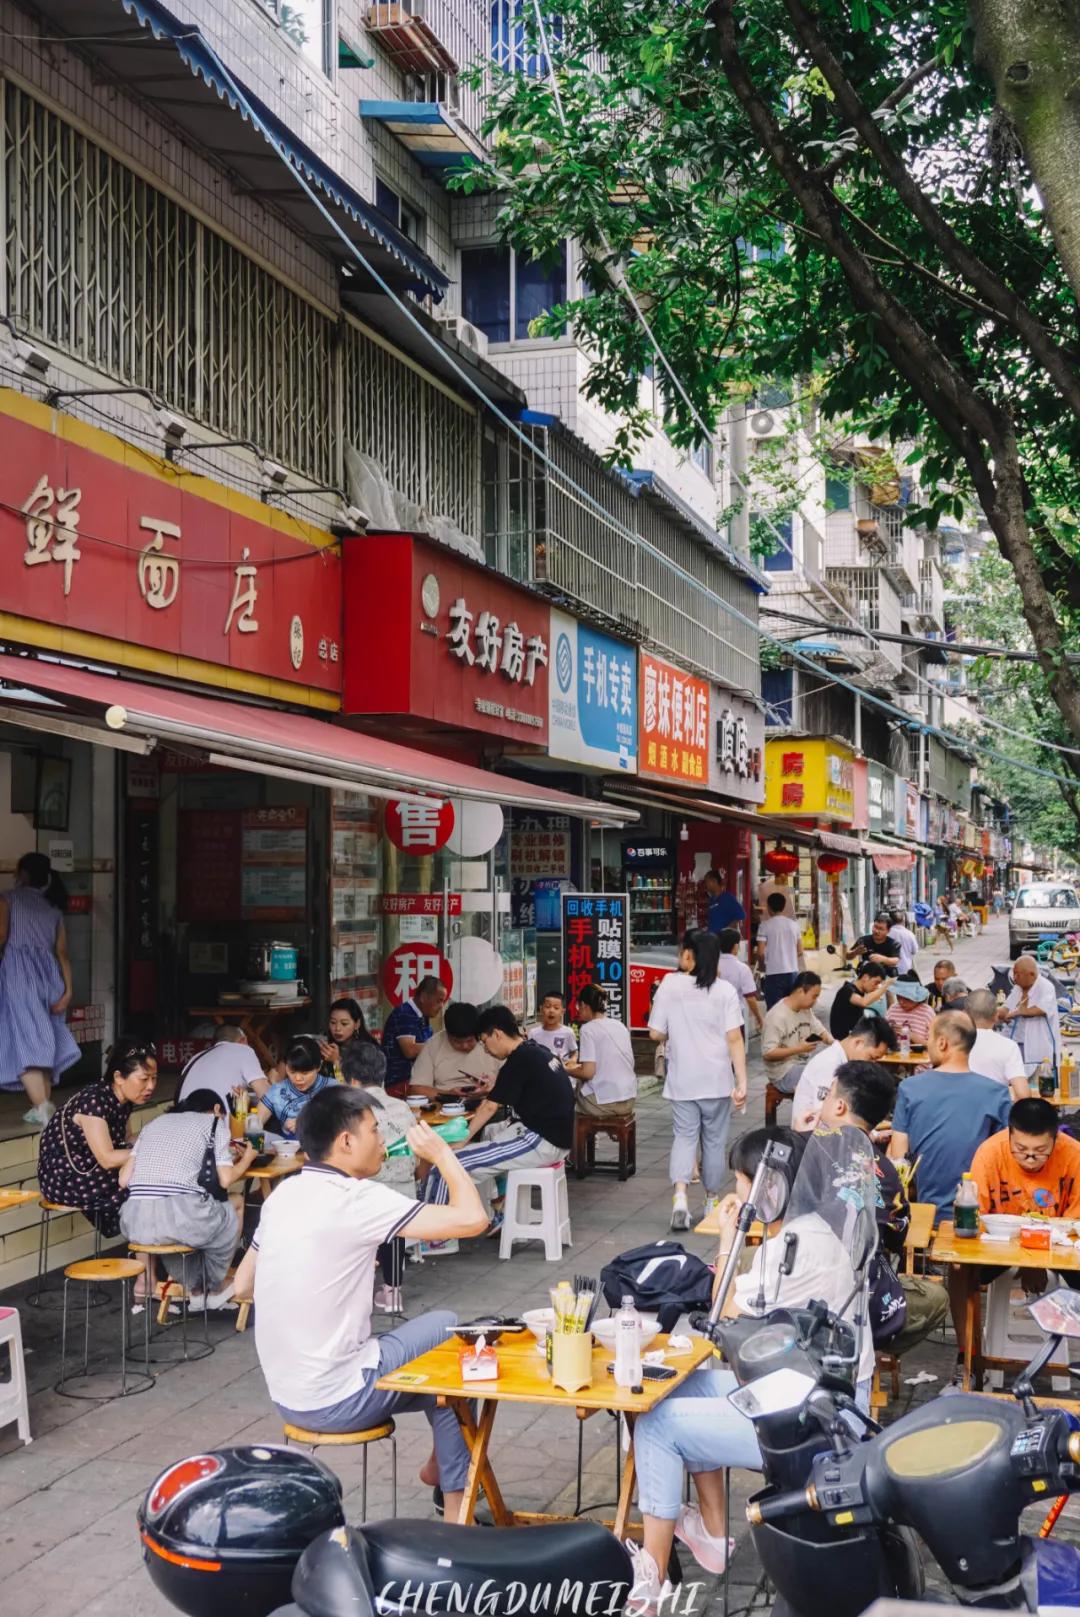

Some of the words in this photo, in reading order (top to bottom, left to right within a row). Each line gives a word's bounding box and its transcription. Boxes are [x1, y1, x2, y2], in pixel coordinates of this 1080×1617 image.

[446, 598, 548, 687] 友好房产
[583, 646, 632, 717] 手机专卖
[637, 848, 667, 857] 百事可乐
[424, 898, 459, 911] 友好产
[568, 900, 623, 916] 回收手机
